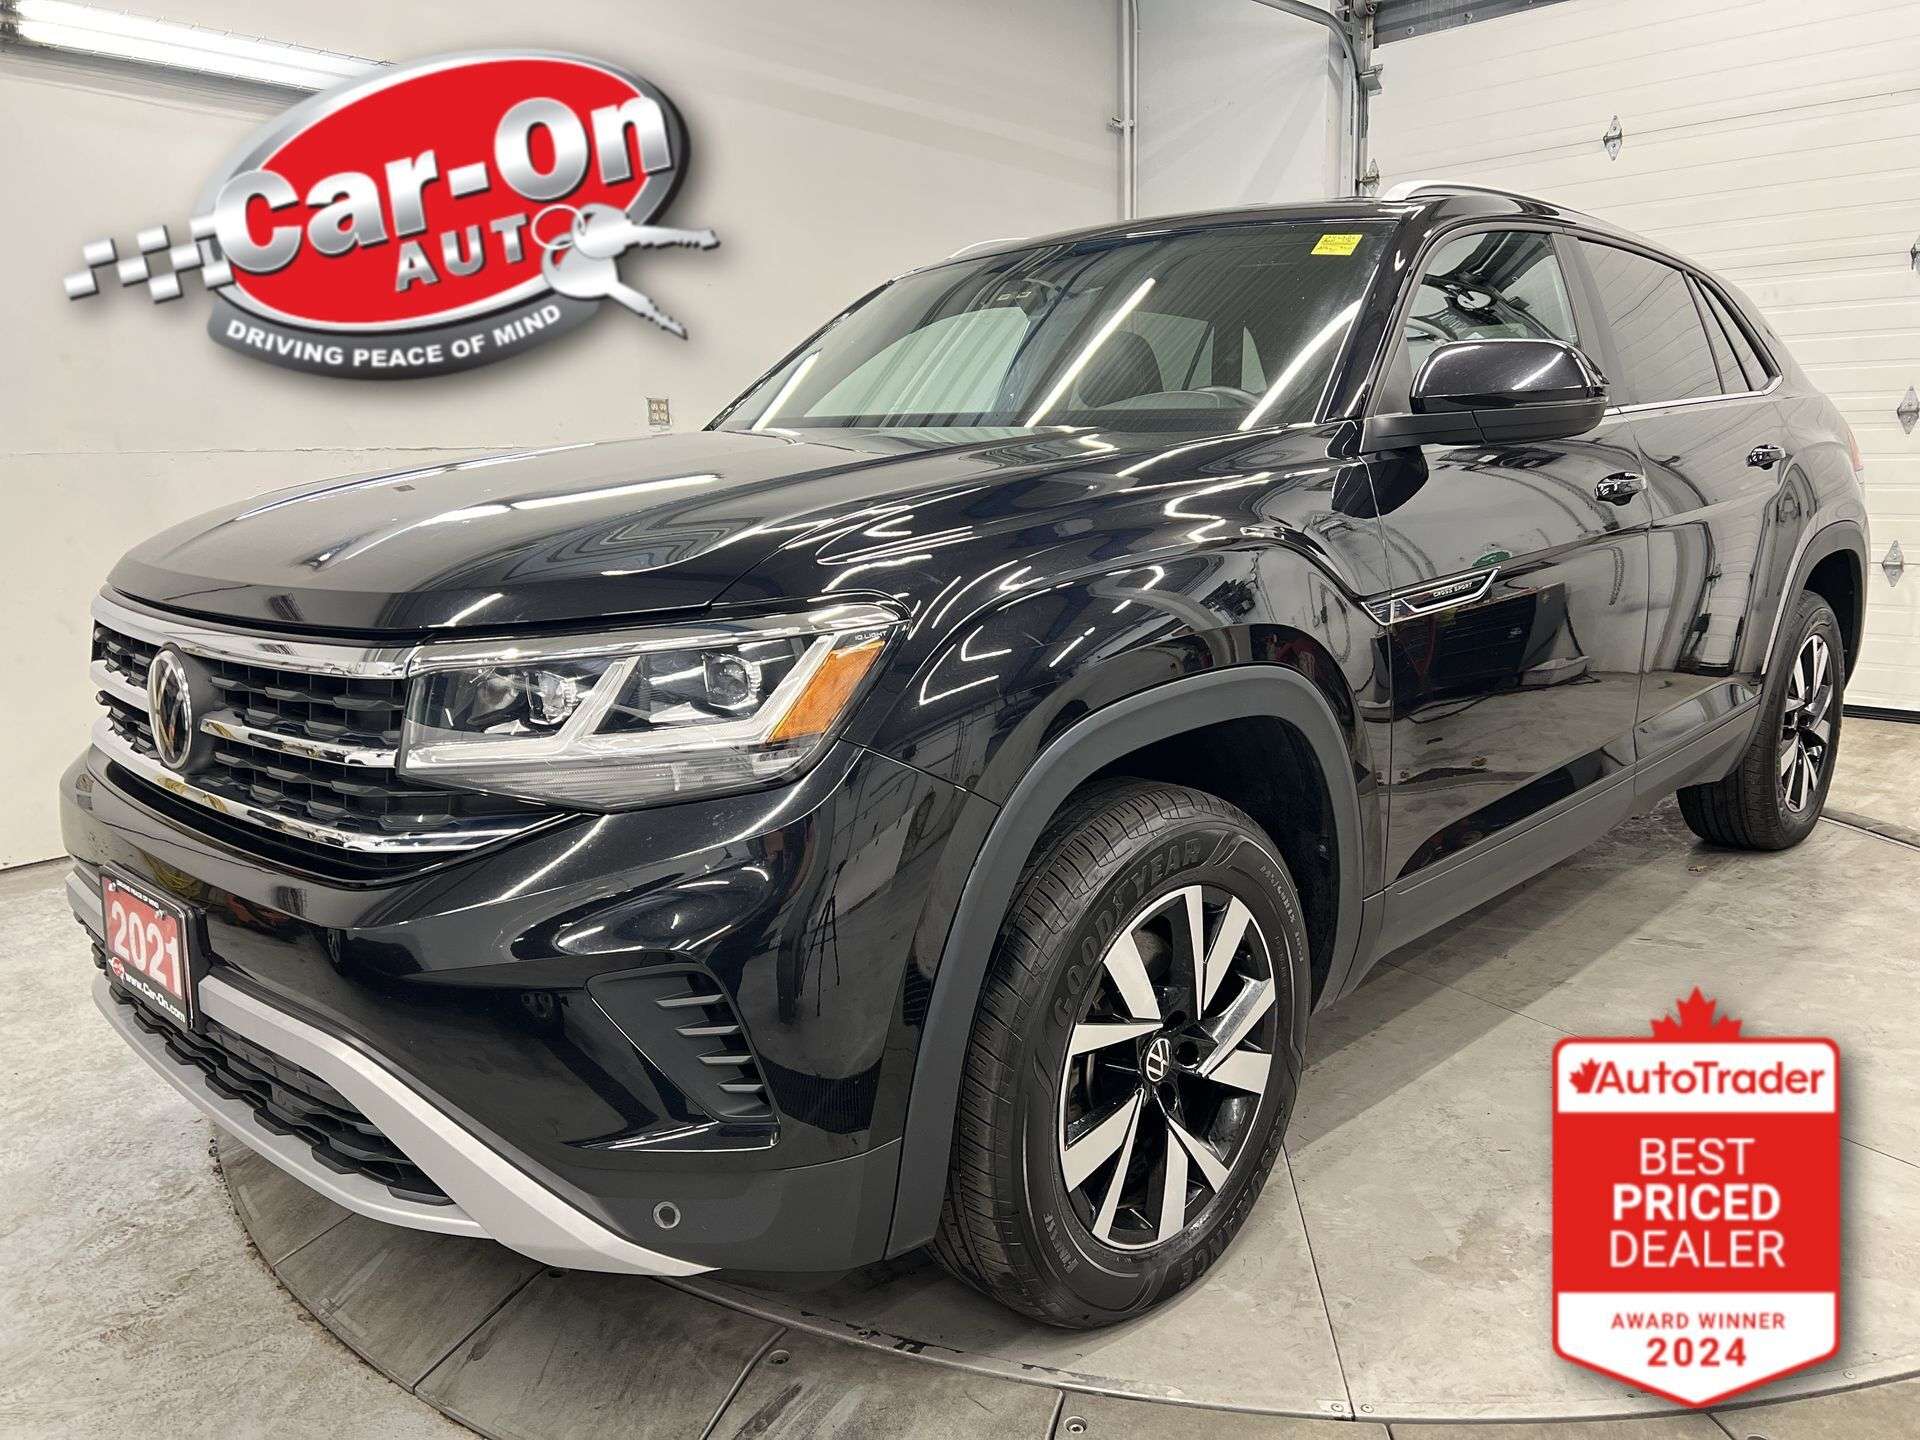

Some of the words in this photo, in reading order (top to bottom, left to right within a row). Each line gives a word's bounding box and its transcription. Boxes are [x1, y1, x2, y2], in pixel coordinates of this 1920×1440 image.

[111, 900, 182, 1000] 2021
[1053, 837, 1204, 1028] GOODYEAR
[124, 971, 186, 1023] www.Car-On.com
